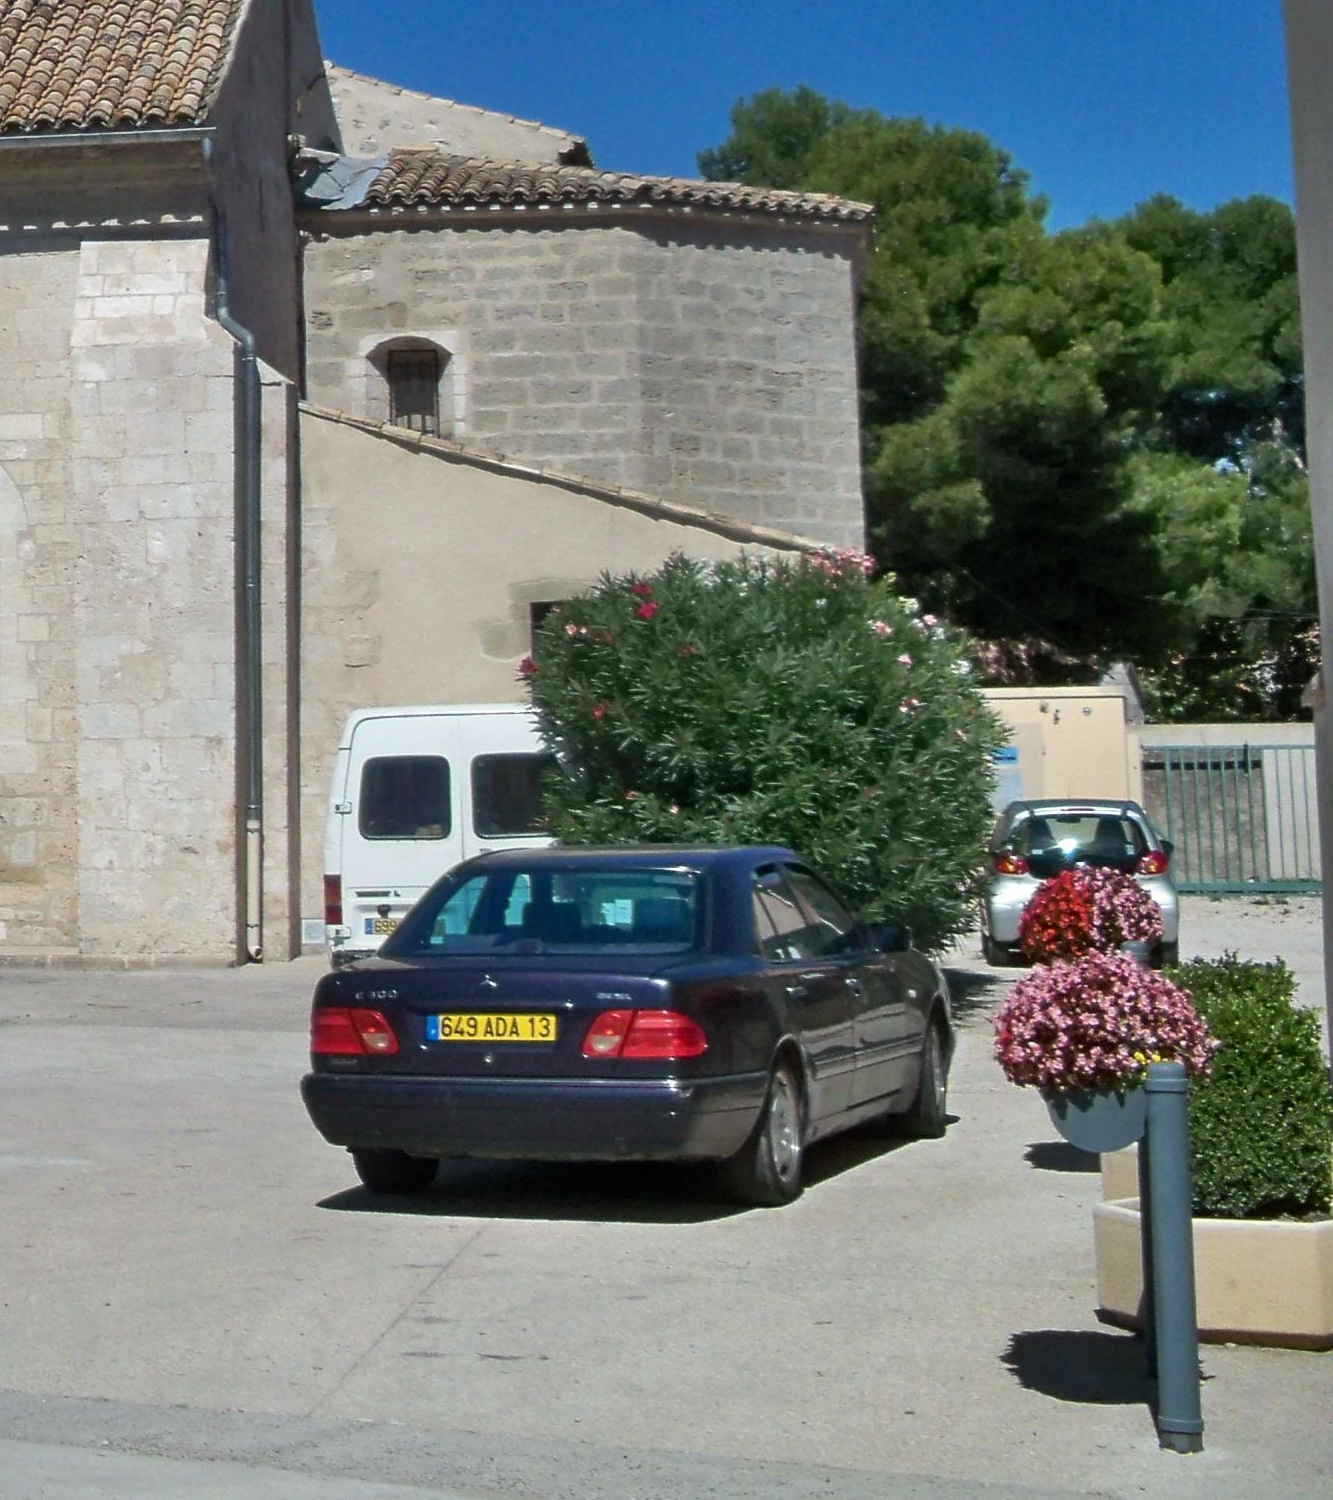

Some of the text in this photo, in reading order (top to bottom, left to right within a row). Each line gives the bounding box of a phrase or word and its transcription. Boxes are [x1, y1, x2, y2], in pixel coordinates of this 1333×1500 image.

[440, 1016, 551, 1038] 649 ADA 13
